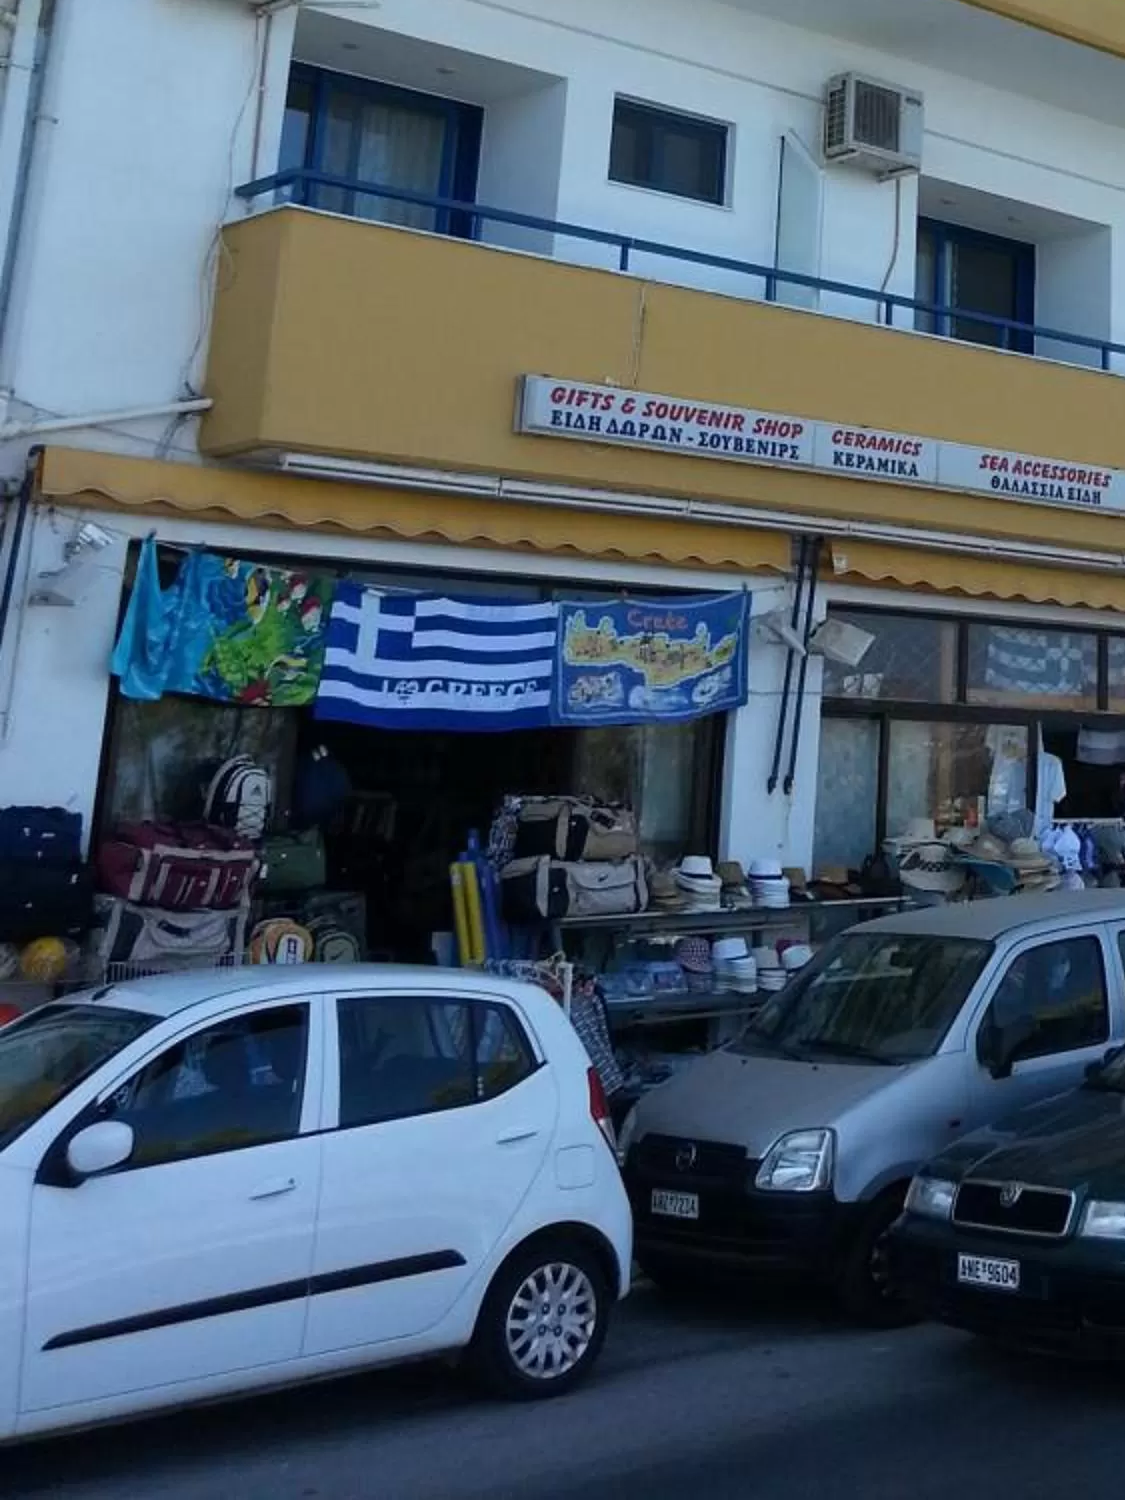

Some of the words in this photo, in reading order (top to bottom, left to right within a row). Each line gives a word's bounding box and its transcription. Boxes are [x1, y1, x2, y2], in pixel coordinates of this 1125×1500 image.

[550, 386, 615, 411] GIFTS
[620, 397, 636, 414] &
[641, 400, 745, 432] SOUVENIR
[751, 418, 804, 439] SHOP
[551, 409, 602, 433] ΕΙΔΗ
[605, 418, 684, 443] ΔΩΡΩΝ
[831, 429, 923, 457] CERAMICS
[979, 453, 1009, 472] SEA
[1012, 458, 1113, 488] ACCESSORIES
